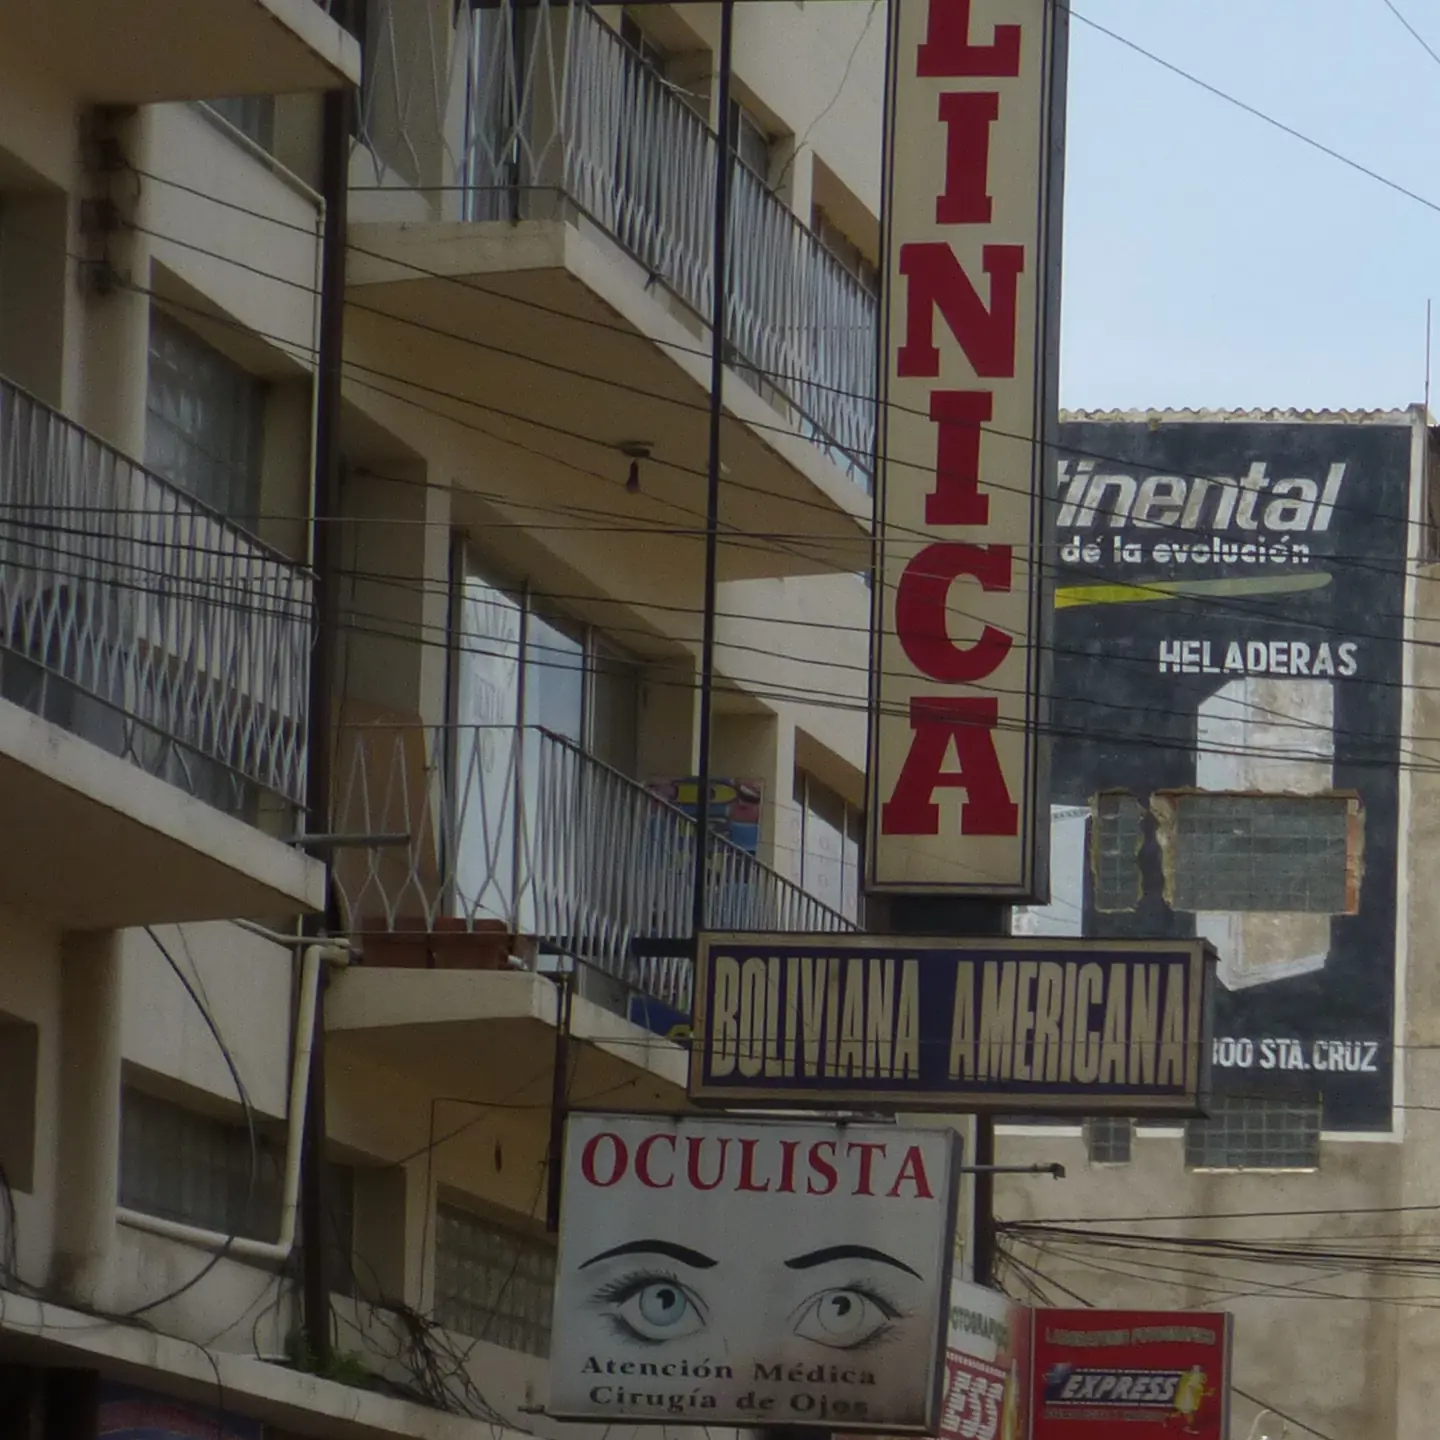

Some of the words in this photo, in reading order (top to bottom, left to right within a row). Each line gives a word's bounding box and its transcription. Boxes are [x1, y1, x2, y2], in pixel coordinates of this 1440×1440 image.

[1114, 535, 1142, 563] la
[1152, 535, 1310, 563] evolución
[1158, 640, 1359, 675] HELADERAS
[711, 956, 920, 1079] BOLIVIANA
[948, 960, 1196, 1086] AMERICANA
[580, 1132, 935, 1199] OCULISTA
[580, 1355, 734, 1380] Atención
[753, 1361, 877, 1386] Médica
[1060, 1374, 1180, 1401] EXPRESS
[588, 1385, 718, 1413] Cirugía
[736, 1391, 775, 1411] de
[789, 1392, 869, 1420] Ojos
